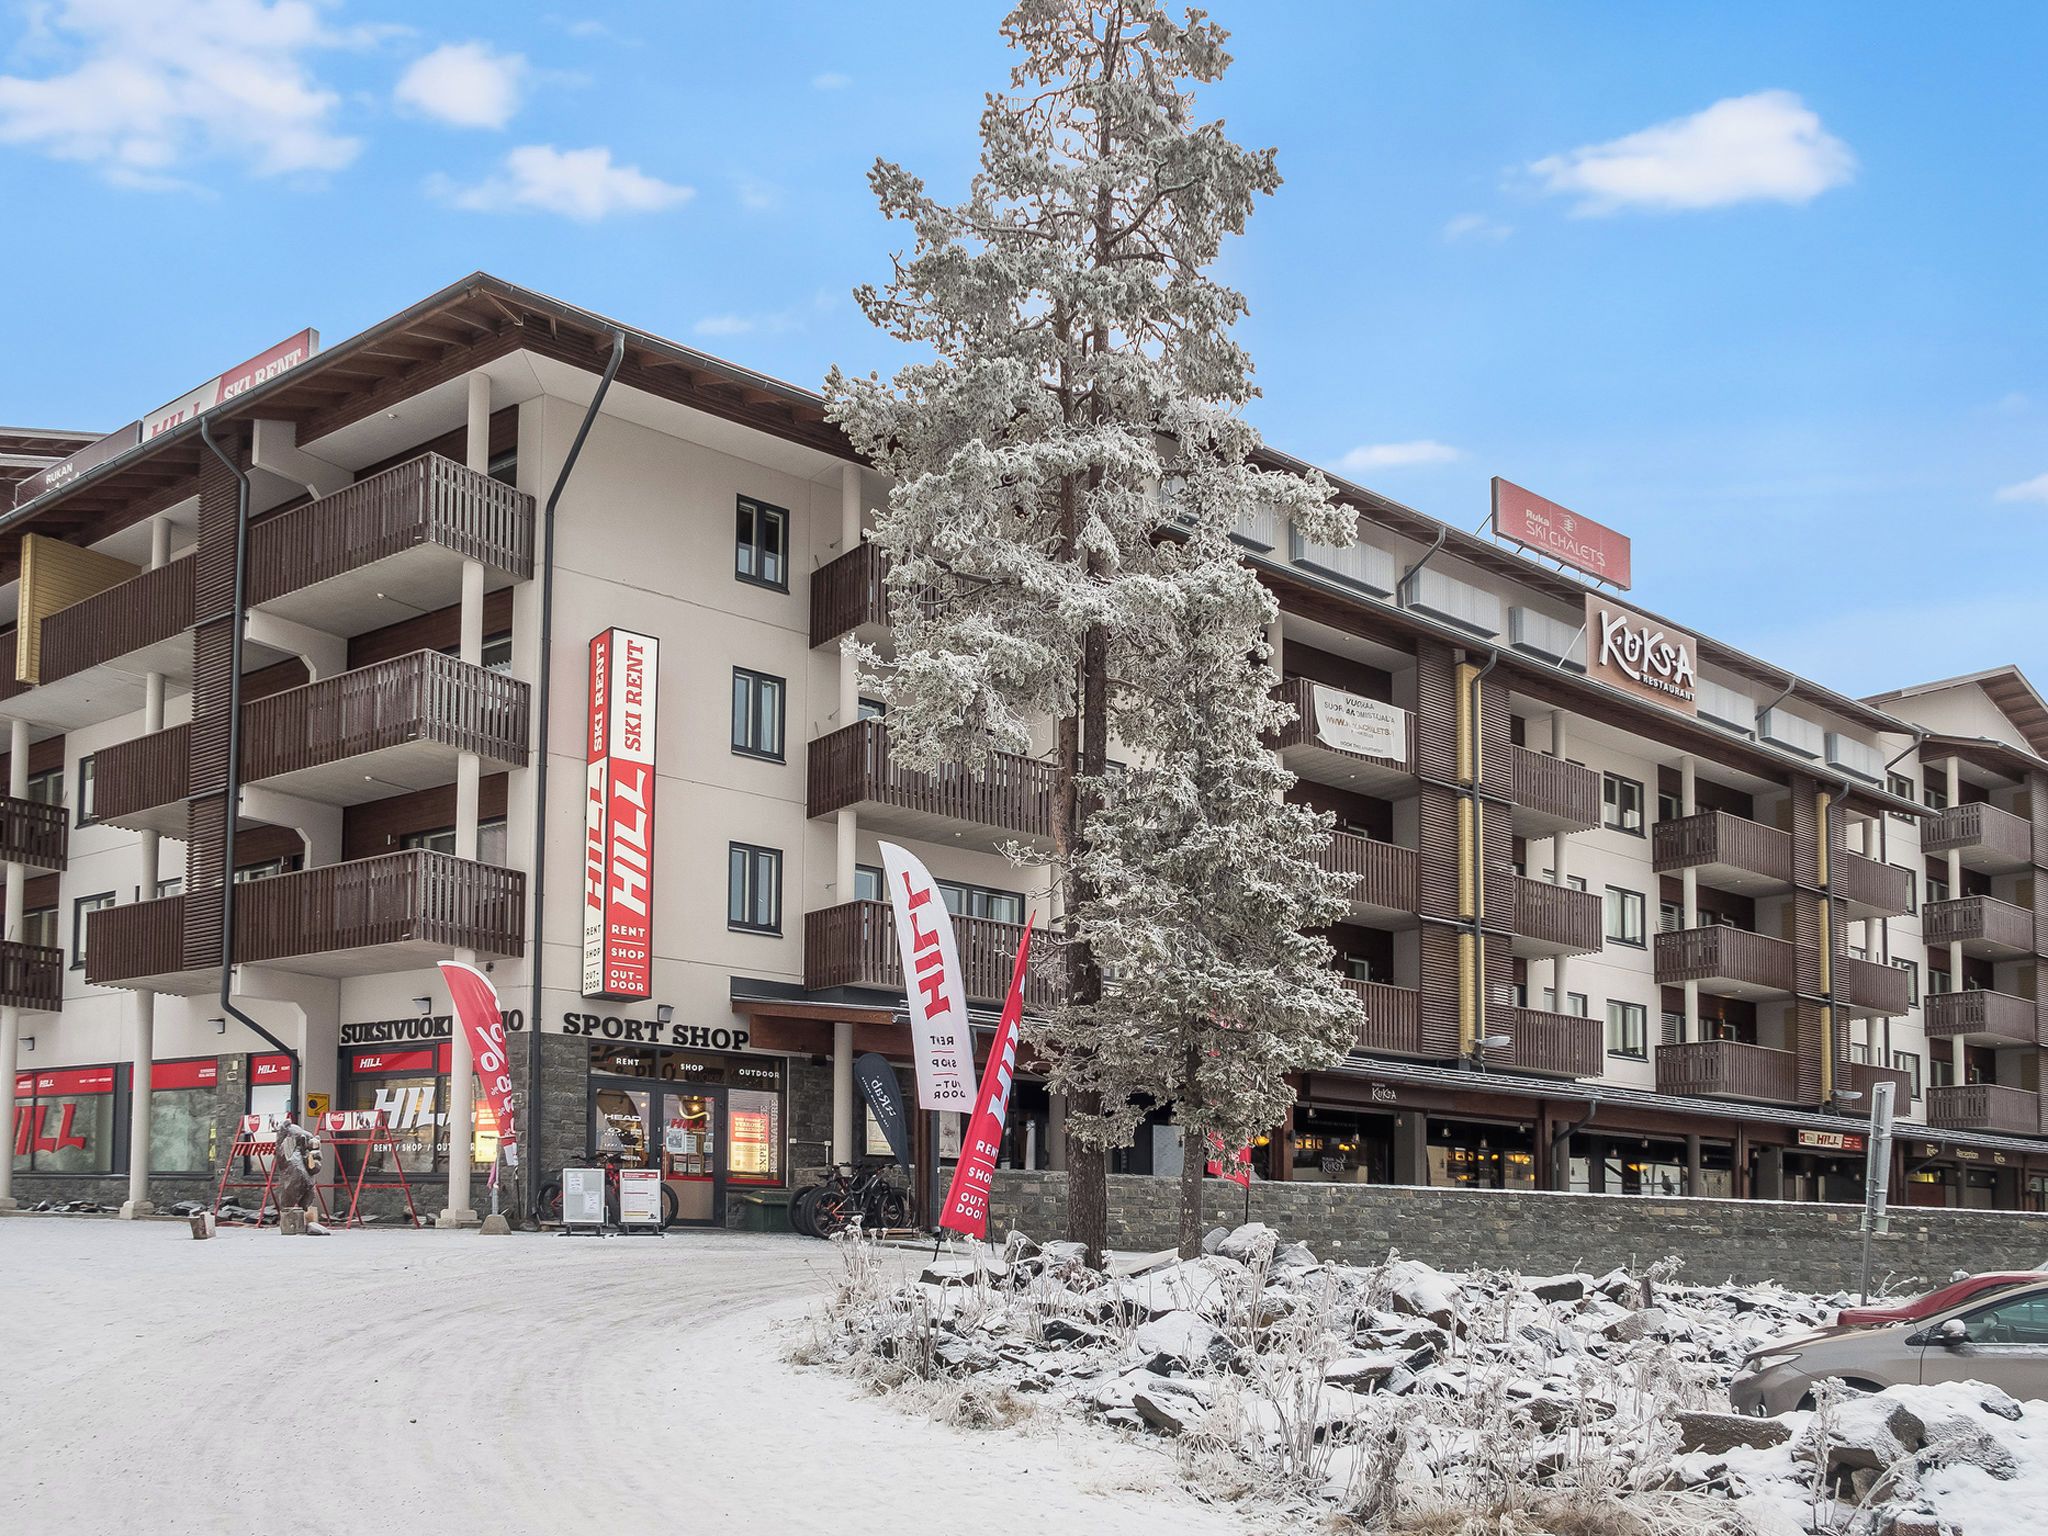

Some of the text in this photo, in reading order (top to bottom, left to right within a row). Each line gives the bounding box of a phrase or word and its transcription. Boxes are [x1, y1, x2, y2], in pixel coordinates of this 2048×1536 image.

[224, 348, 302, 400] SKI RENT
[45, 463, 73, 485] RUKAN
[1526, 509, 1549, 527] Ruka
[1526, 520, 1546, 541] SKI
[1549, 531, 1606, 567] CHALETS
[1599, 610, 1695, 689] KUKSA
[625, 640, 643, 752] SKI RENT
[1642, 674, 1696, 702] RESTAURANT
[594, 643, 605, 752] SKI RENT
[587, 767, 603, 911] HILL
[612, 768, 647, 917] HILL
[586, 924, 601, 936] RENT
[611, 924, 645, 938] RENT
[586, 947, 601, 959] SHOP
[611, 947, 645, 960] SHOP
[610, 969, 642, 980] OUT-
[585, 979, 600, 990] DOOR
[610, 979, 644, 992] DOOR
[341, 1009, 524, 1044] SUKSIVUOKO
[563, 1012, 749, 1051] SPORT SHOP
[257, 1064, 277, 1075] HILL
[359, 1058, 382, 1069] HILL
[616, 1057, 640, 1066] RENT
[680, 1063, 704, 1072] SHOP
[739, 1068, 780, 1079] OUTDOOR
[374, 1086, 477, 1130] HIL
[604, 1113, 642, 1121] HEAD
[13, 1104, 86, 1156] ILL
[769, 1099, 778, 1173] REAL NATURE
[373, 1143, 392, 1152] RENT
[402, 1143, 422, 1152] SHOP
[437, 1143, 475, 1152] OUTR
[1817, 1134, 1839, 1145] HILL
[956, 1203, 983, 1220] DOO
